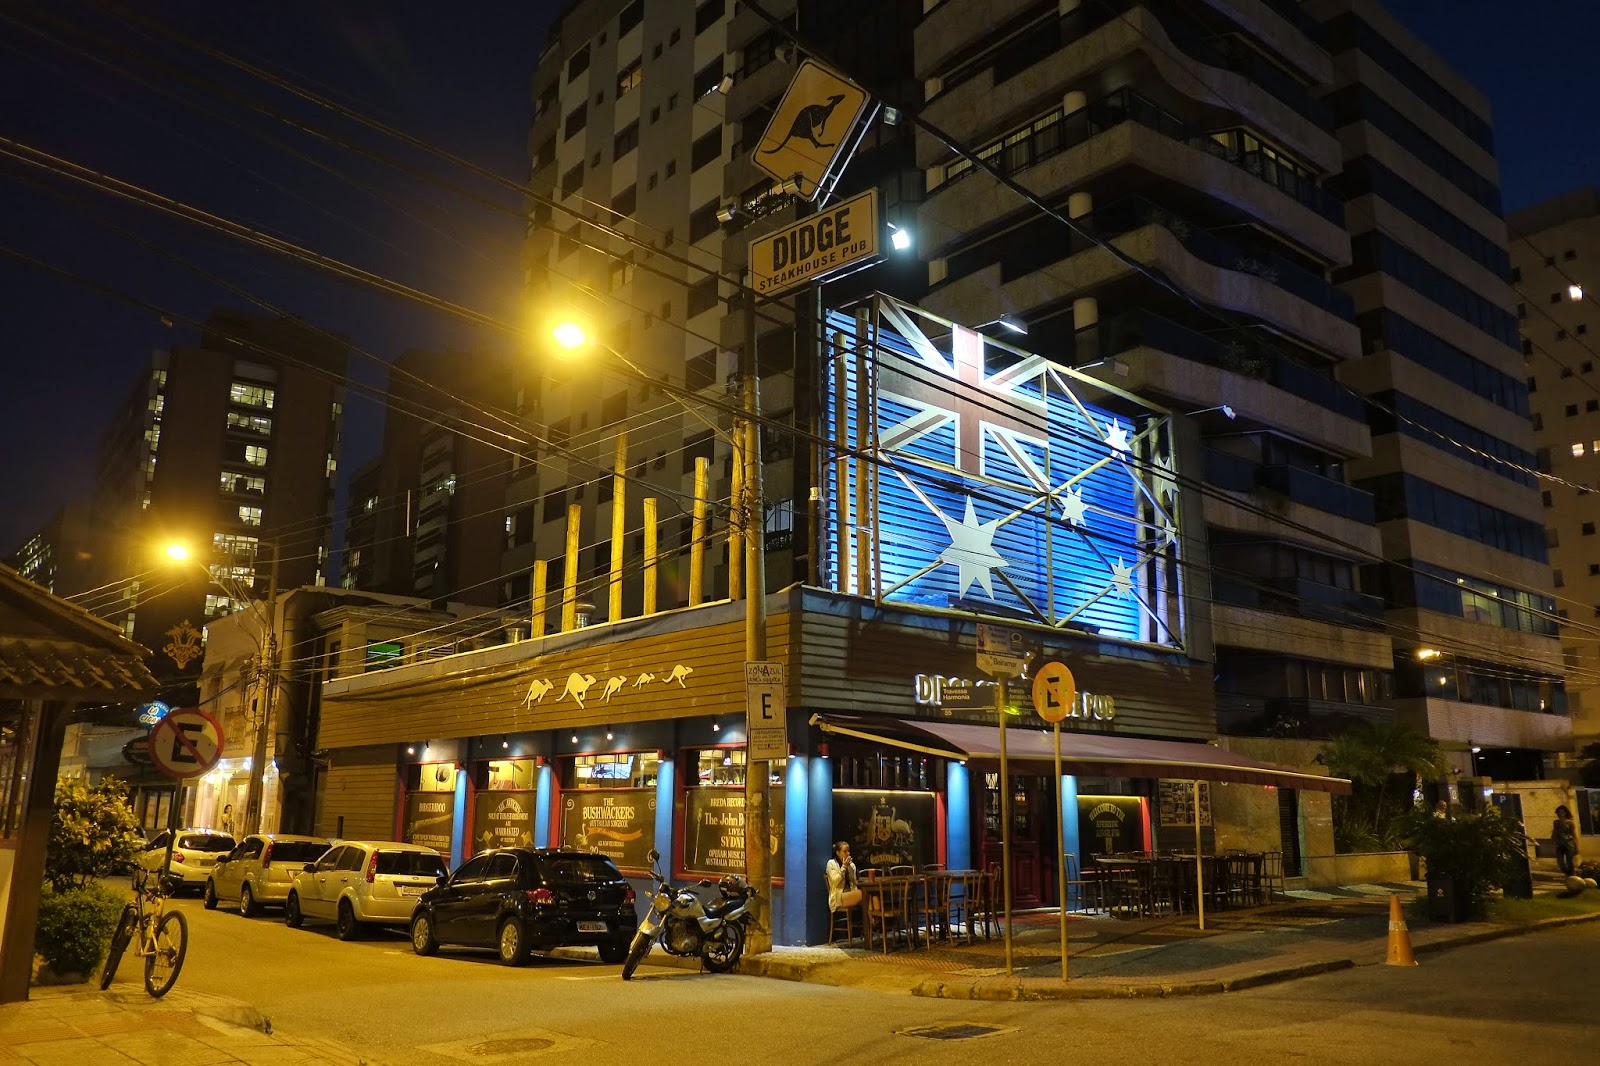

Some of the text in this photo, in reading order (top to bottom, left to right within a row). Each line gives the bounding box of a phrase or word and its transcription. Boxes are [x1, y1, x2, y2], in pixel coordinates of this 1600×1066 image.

[773, 207, 851, 271] DIDGE
[759, 239, 867, 290] STEAKHOUSE PUB
[762, 693, 773, 719] E
[171, 722, 203, 763] E
[583, 807, 635, 819] BUSHWACKERS
[603, 798, 615, 806] THE
[705, 813, 718, 825] The
[720, 813, 738, 826] John
